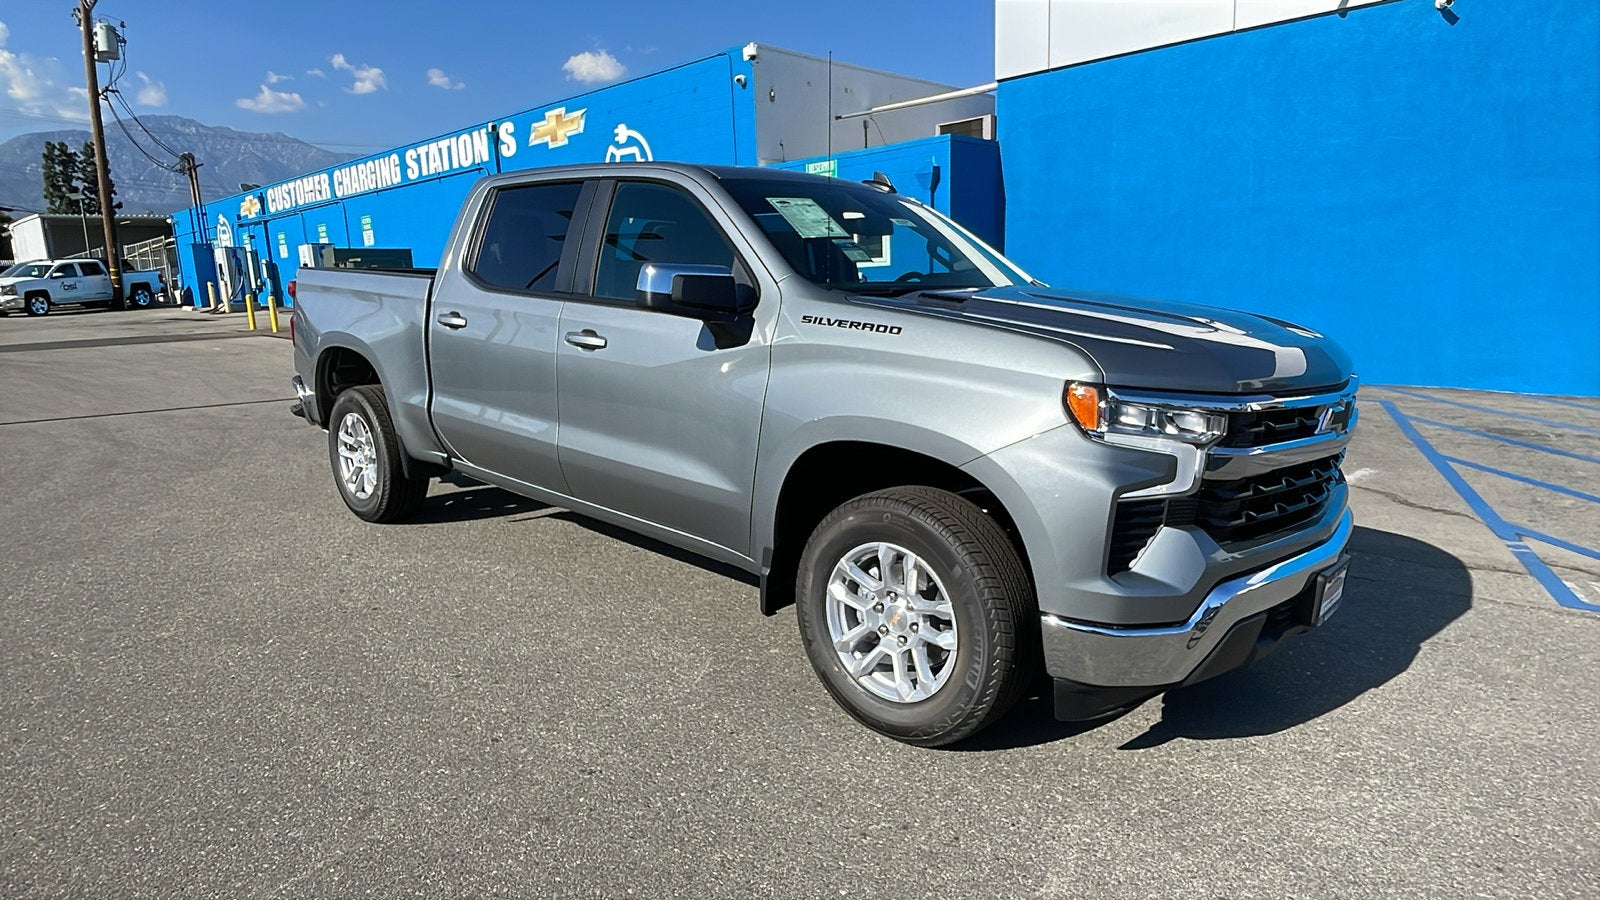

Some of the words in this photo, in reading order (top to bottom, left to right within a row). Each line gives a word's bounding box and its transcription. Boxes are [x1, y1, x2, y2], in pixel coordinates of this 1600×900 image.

[266, 173, 331, 213] CUSTOMER
[333, 153, 401, 197] CHARGING
[801, 315, 903, 336] SILVERADO
